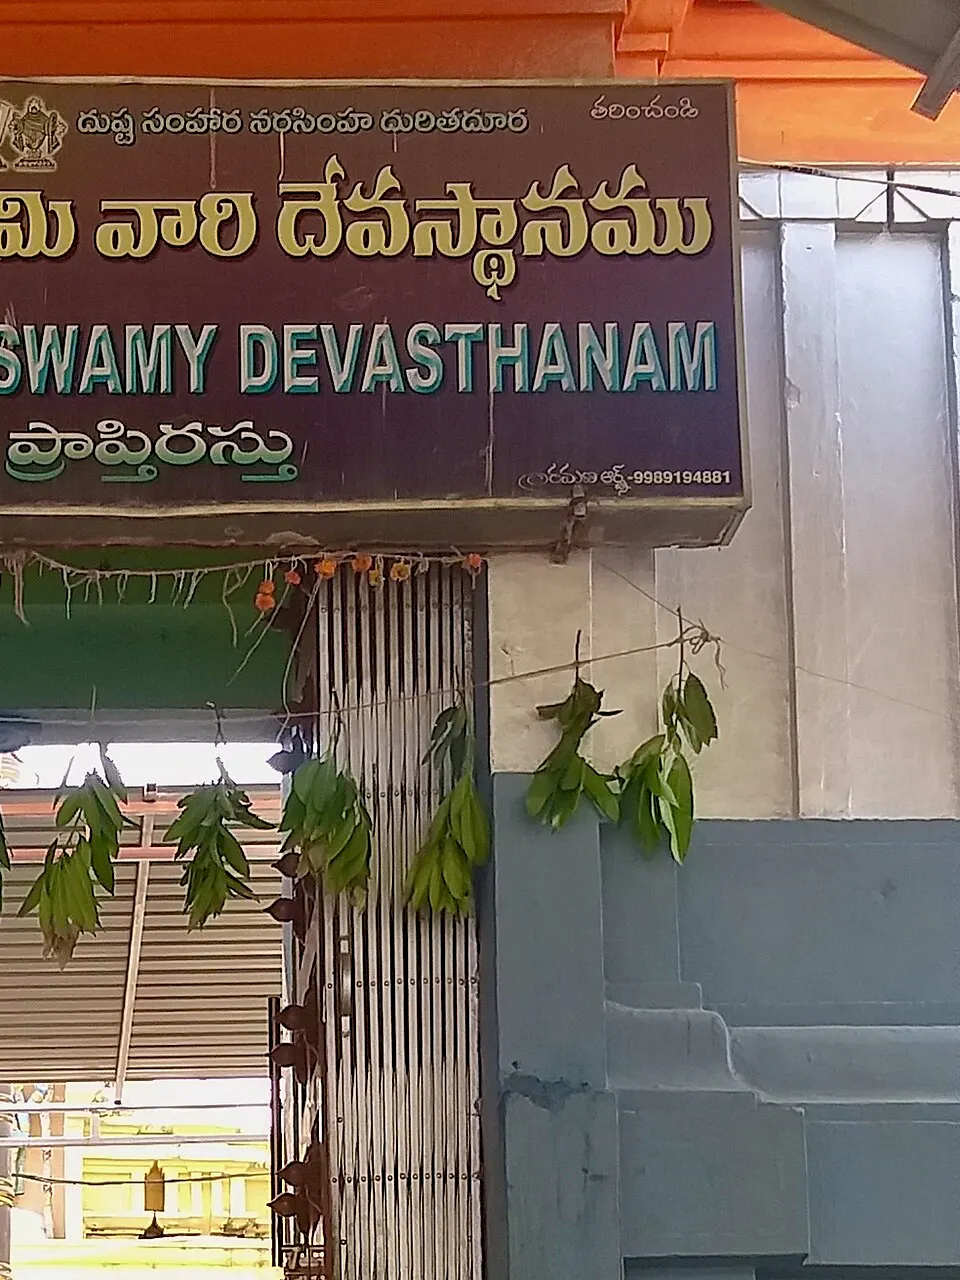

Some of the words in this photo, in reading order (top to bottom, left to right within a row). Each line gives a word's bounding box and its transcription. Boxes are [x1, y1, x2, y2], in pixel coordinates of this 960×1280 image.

[77, 107, 135, 144] దుష్ట
[142, 107, 241, 133] సంహార
[249, 107, 372, 133] నరసింహ
[590, 95, 699, 118] తరించండి
[95, 191, 257, 259] వారి
[277, 155, 713, 300] దేవస్థానము
[239, 321, 718, 394] DEVASTHANAM
[5, 419, 298, 482] ప్రాప్తిరస్తు
